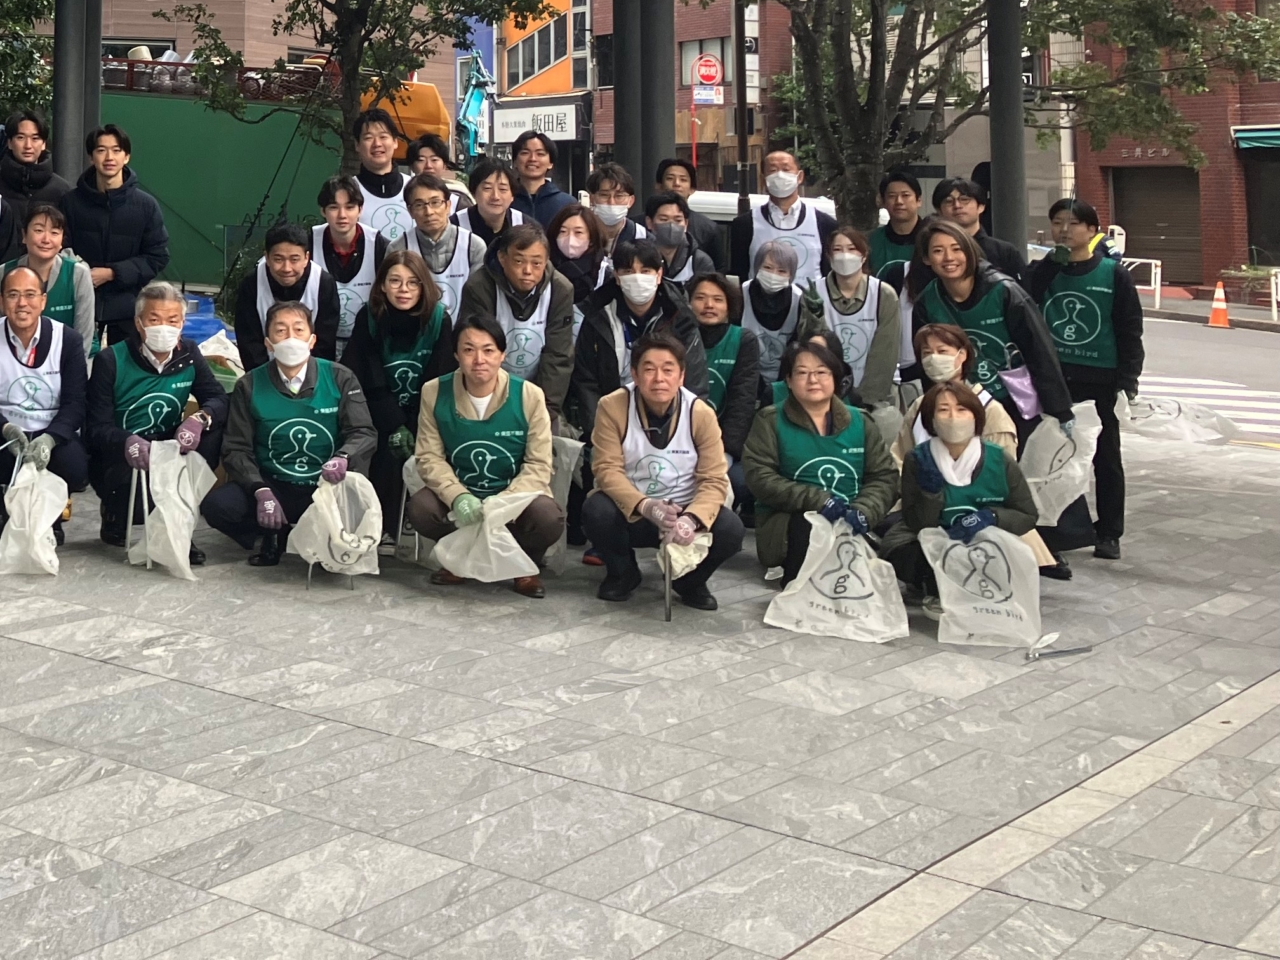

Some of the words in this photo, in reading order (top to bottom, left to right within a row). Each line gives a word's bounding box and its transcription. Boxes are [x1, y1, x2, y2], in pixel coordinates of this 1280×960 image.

[531, 112, 568, 133] 飯田屋
[1074, 347, 1098, 357] bird
[972, 605, 1002, 615] green
